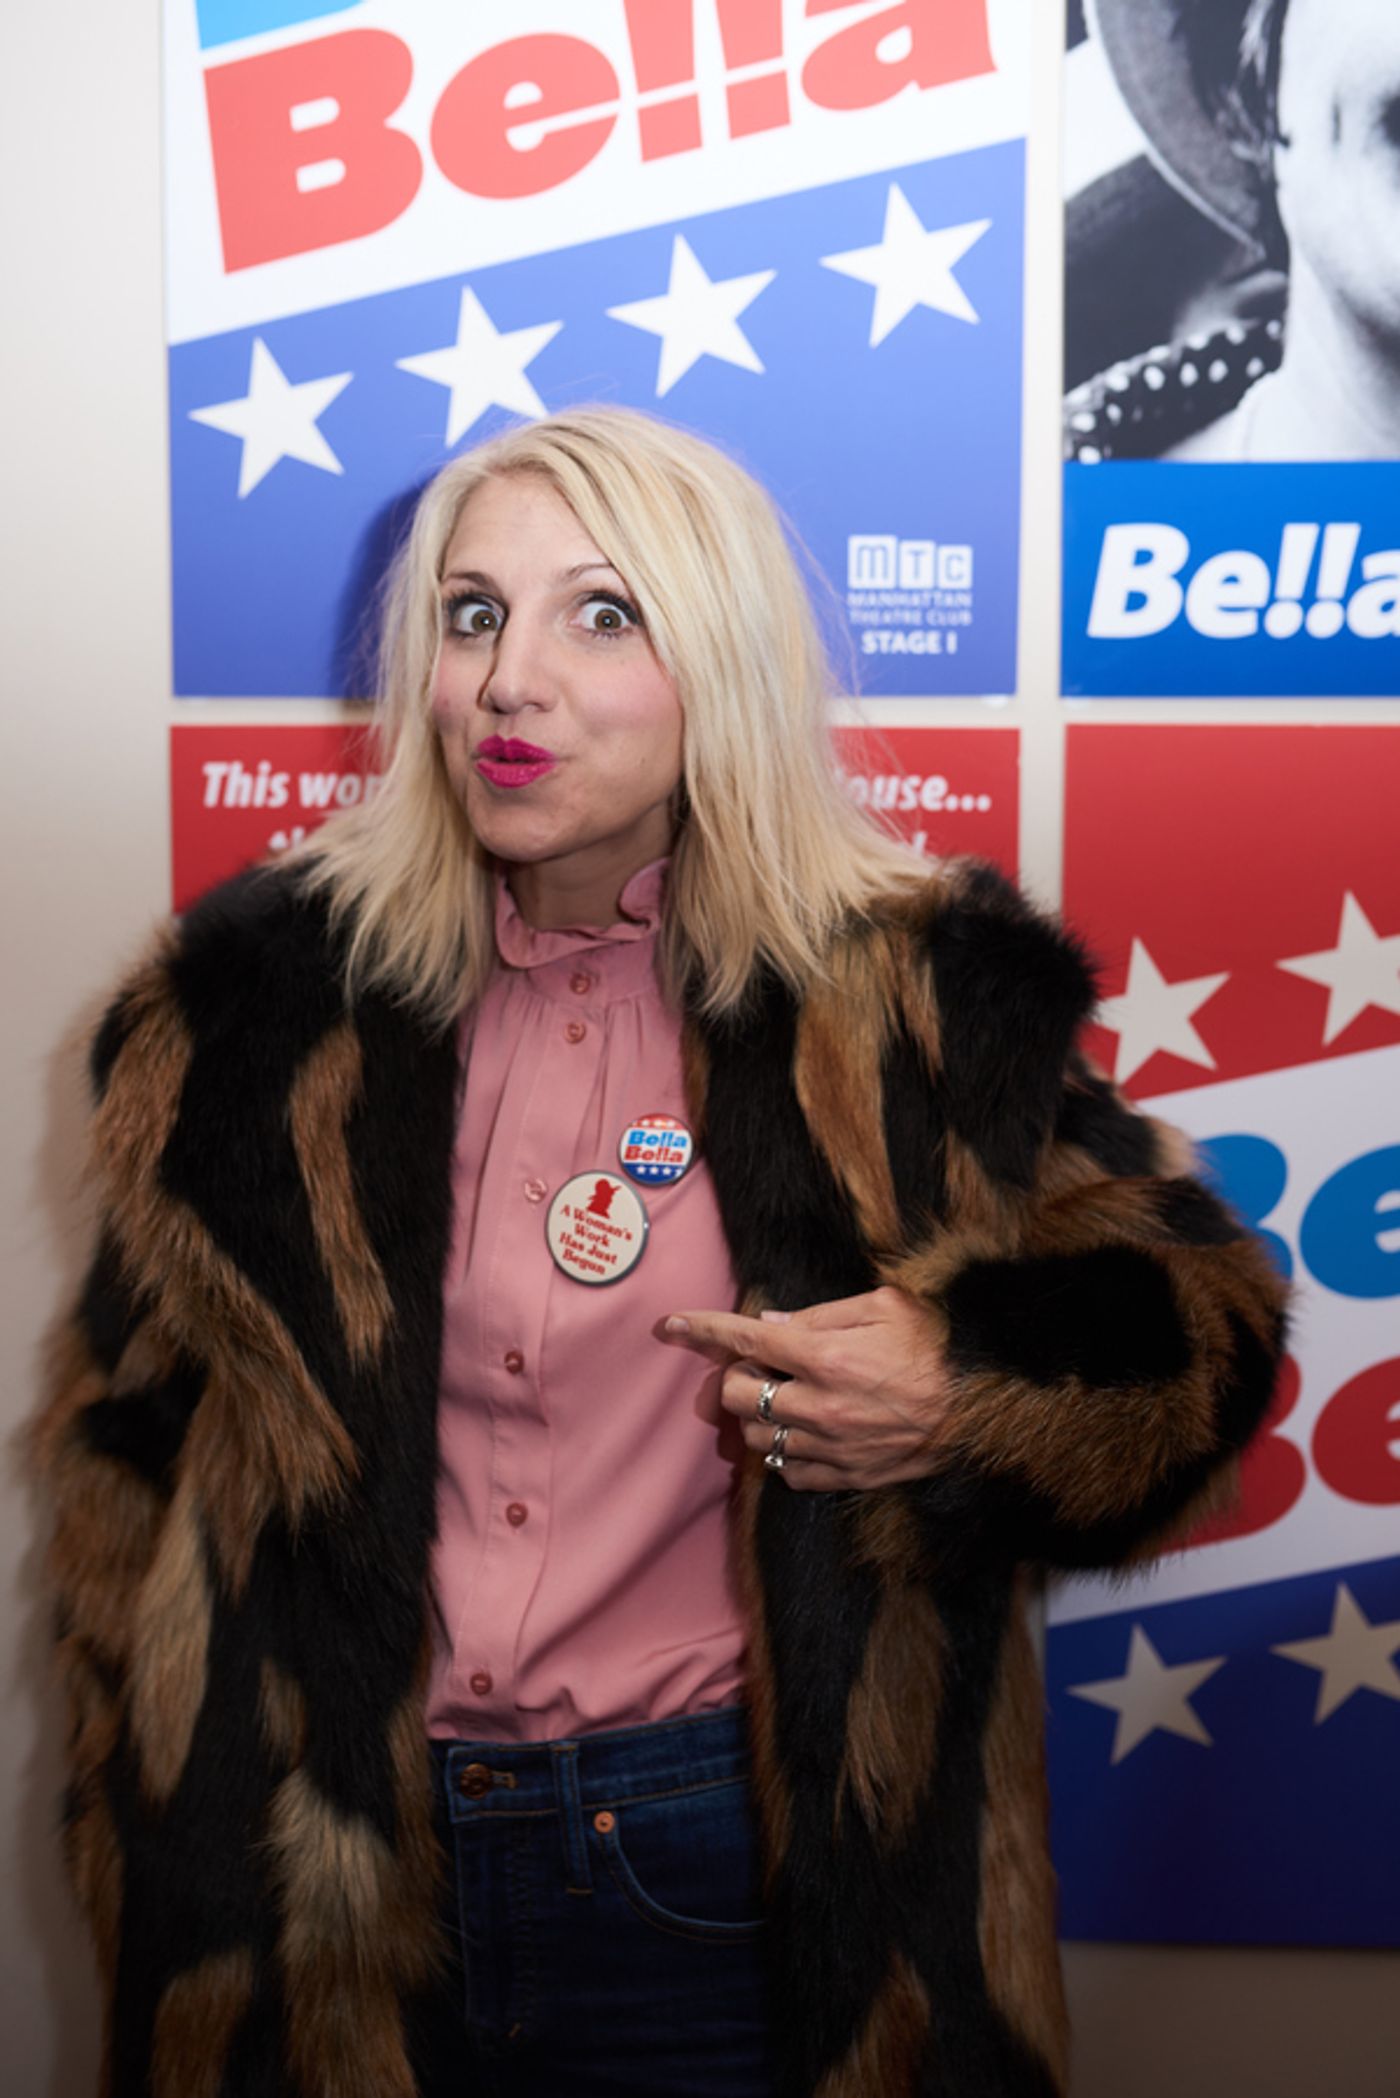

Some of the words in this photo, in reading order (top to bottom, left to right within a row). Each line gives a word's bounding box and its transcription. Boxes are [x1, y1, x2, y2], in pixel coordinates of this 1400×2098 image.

[849, 535, 972, 589] MTC
[847, 591, 972, 608] MANHATTAN
[862, 630, 942, 655] STAGE
[202, 760, 290, 809] This
[836, 768, 992, 812] ouse...
[560, 1204, 571, 1217] A
[574, 1207, 633, 1241] Woman's
[575, 1223, 611, 1247] Work
[559, 1232, 585, 1252] Has
[587, 1244, 617, 1265] Just
[562, 1248, 606, 1275] Begun
